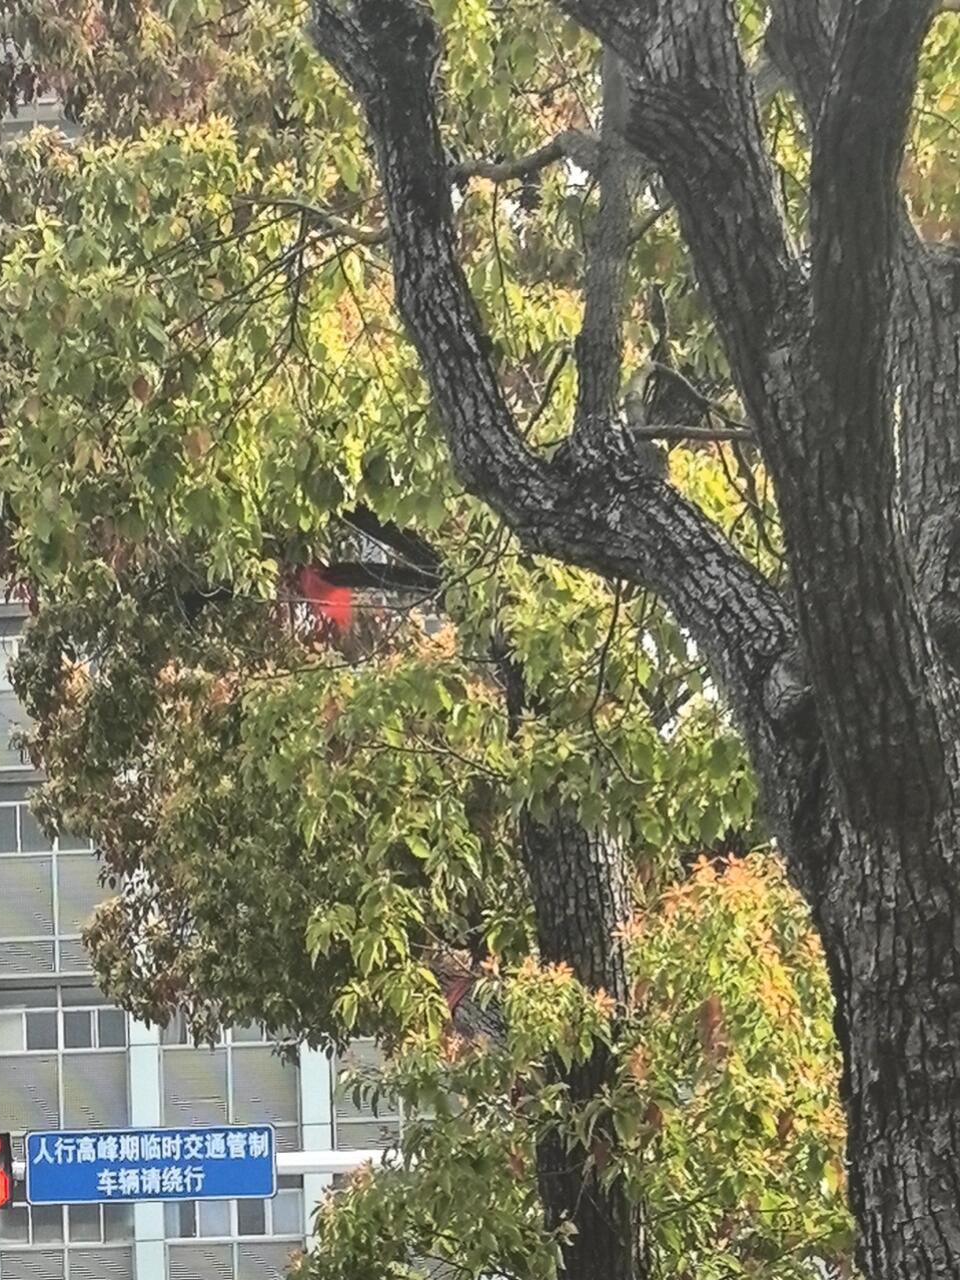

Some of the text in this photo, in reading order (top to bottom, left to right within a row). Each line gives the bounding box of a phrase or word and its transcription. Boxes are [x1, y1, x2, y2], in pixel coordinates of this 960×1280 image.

[32, 1131, 269, 1164] 人行高峰期临时交通管制
[96, 1165, 206, 1196] 车辆请绕行
